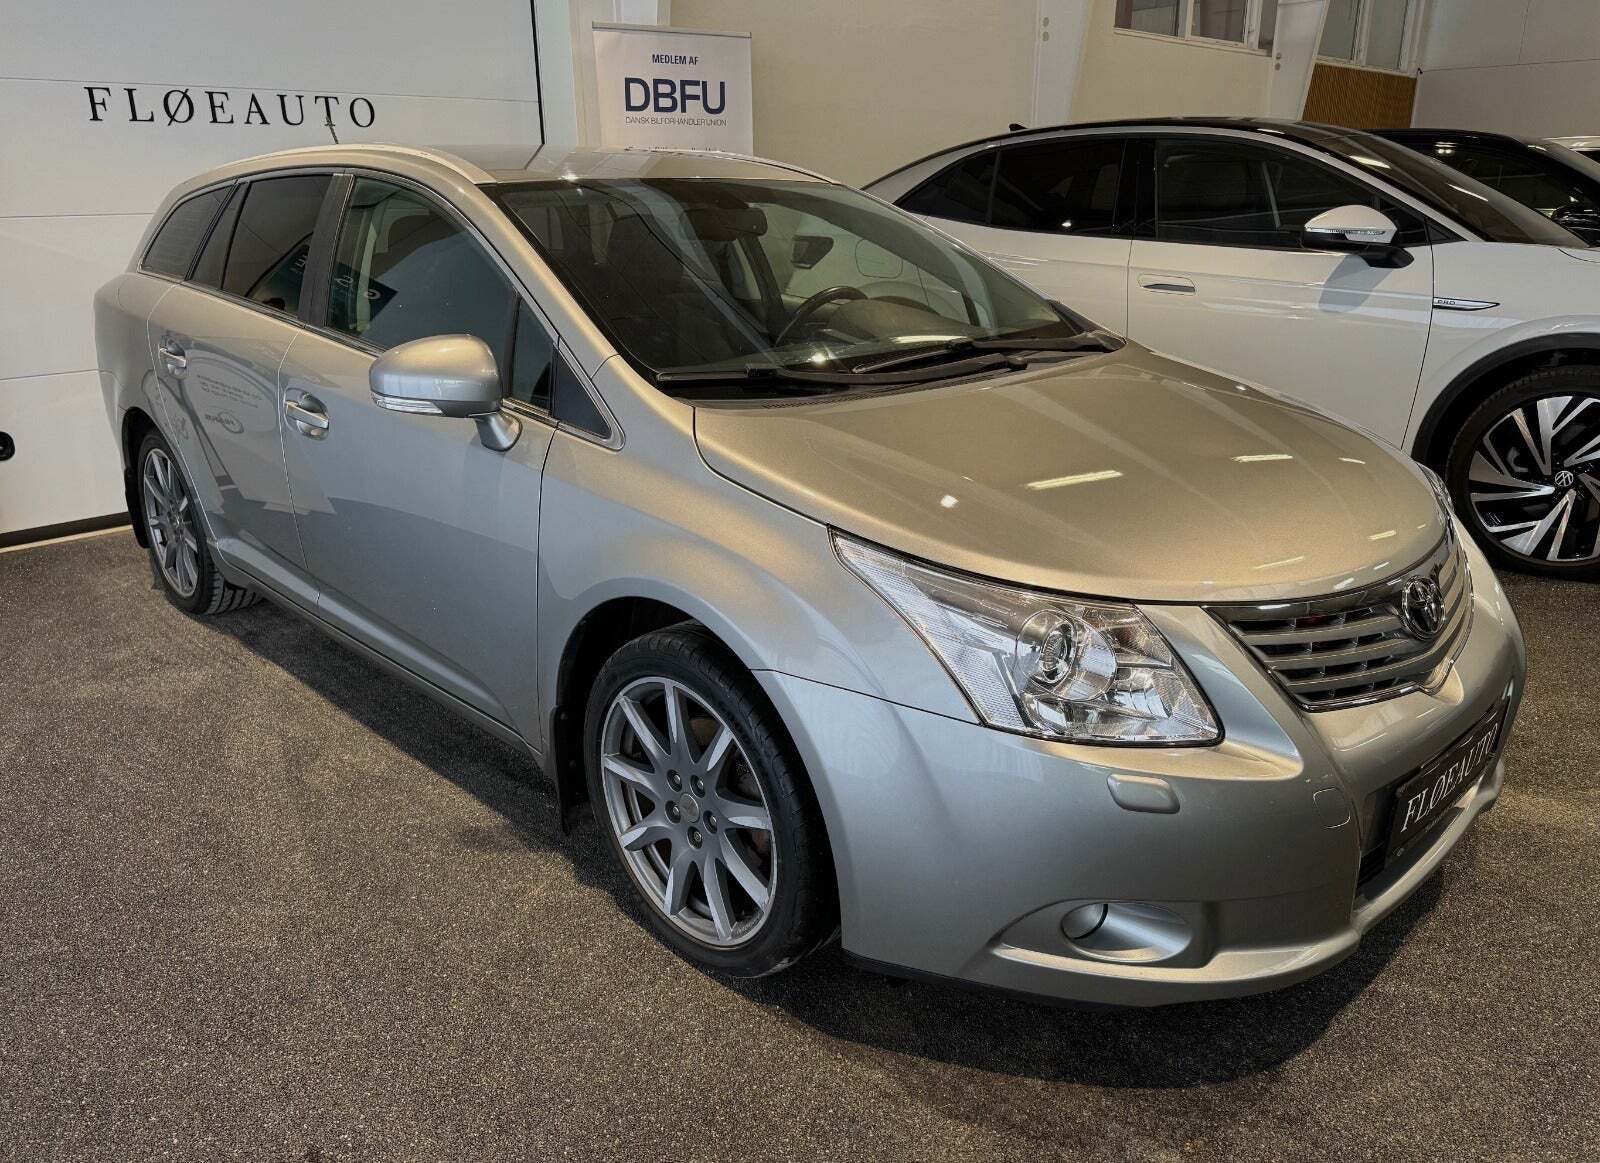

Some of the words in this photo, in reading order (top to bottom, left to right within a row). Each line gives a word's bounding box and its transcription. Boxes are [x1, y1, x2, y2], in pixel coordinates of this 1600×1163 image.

[652, 53, 687, 65] MEDLEM
[688, 56, 700, 66] AF
[84, 86, 376, 128] FLØEAUTO
[624, 77, 726, 115] DBFU
[625, 116, 650, 125] DANSK
[705, 118, 727, 127] UNION
